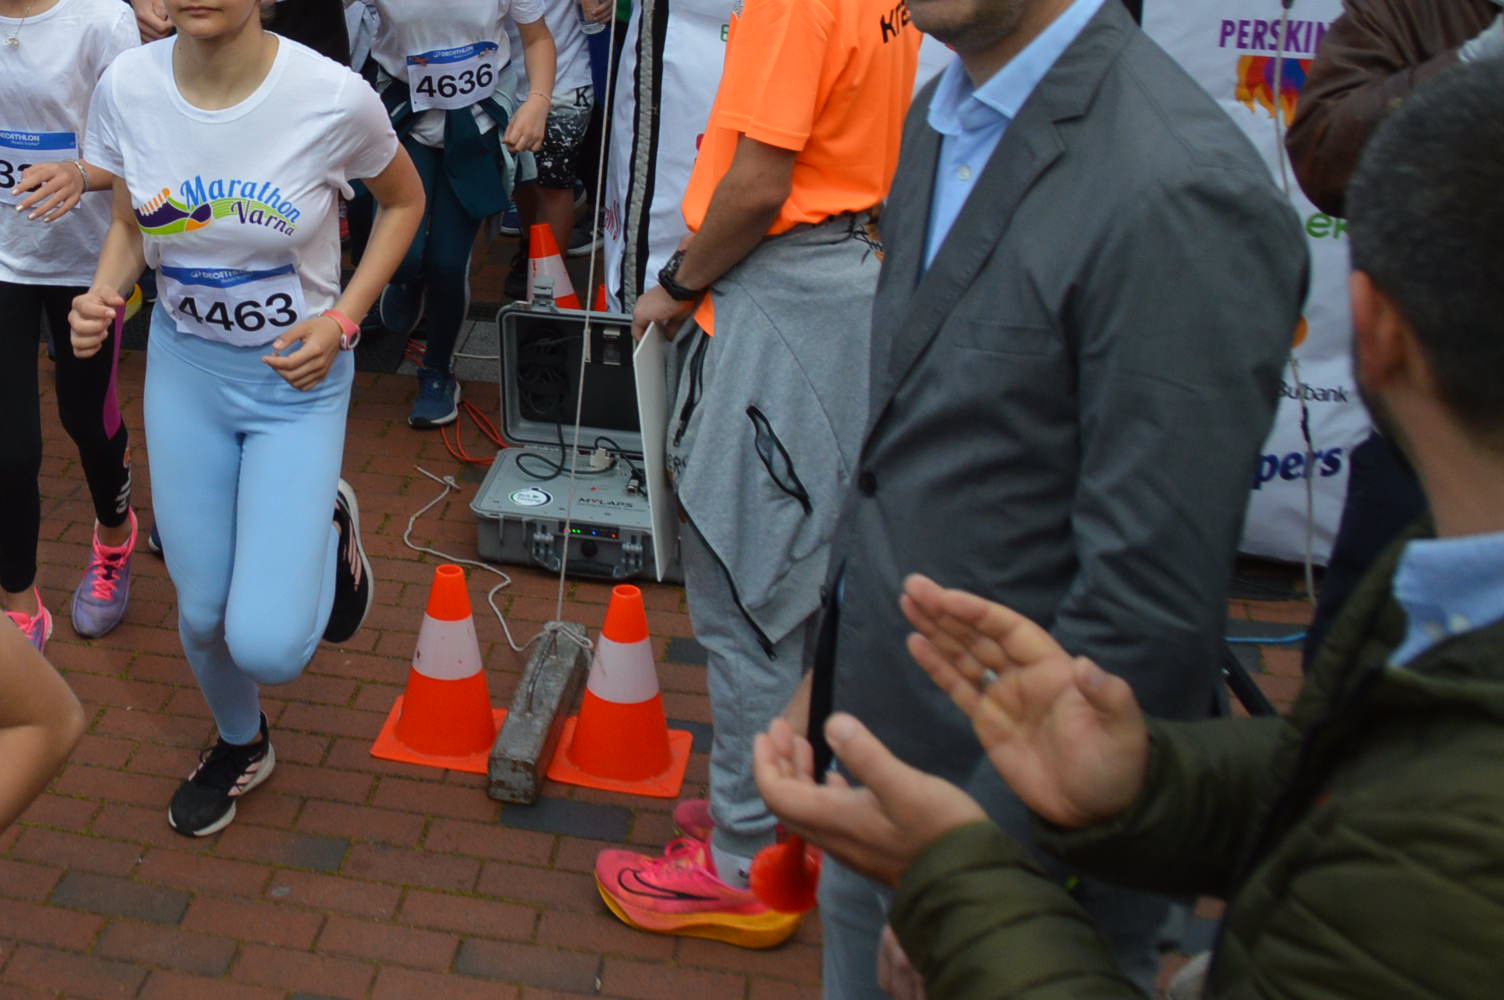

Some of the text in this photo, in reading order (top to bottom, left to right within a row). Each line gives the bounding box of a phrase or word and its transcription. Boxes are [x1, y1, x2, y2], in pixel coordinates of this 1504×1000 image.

[416, 63, 494, 99] 4636
[180, 175, 301, 223] Marathon
[231, 200, 296, 236] Varna
[178, 293, 297, 332] 4463
